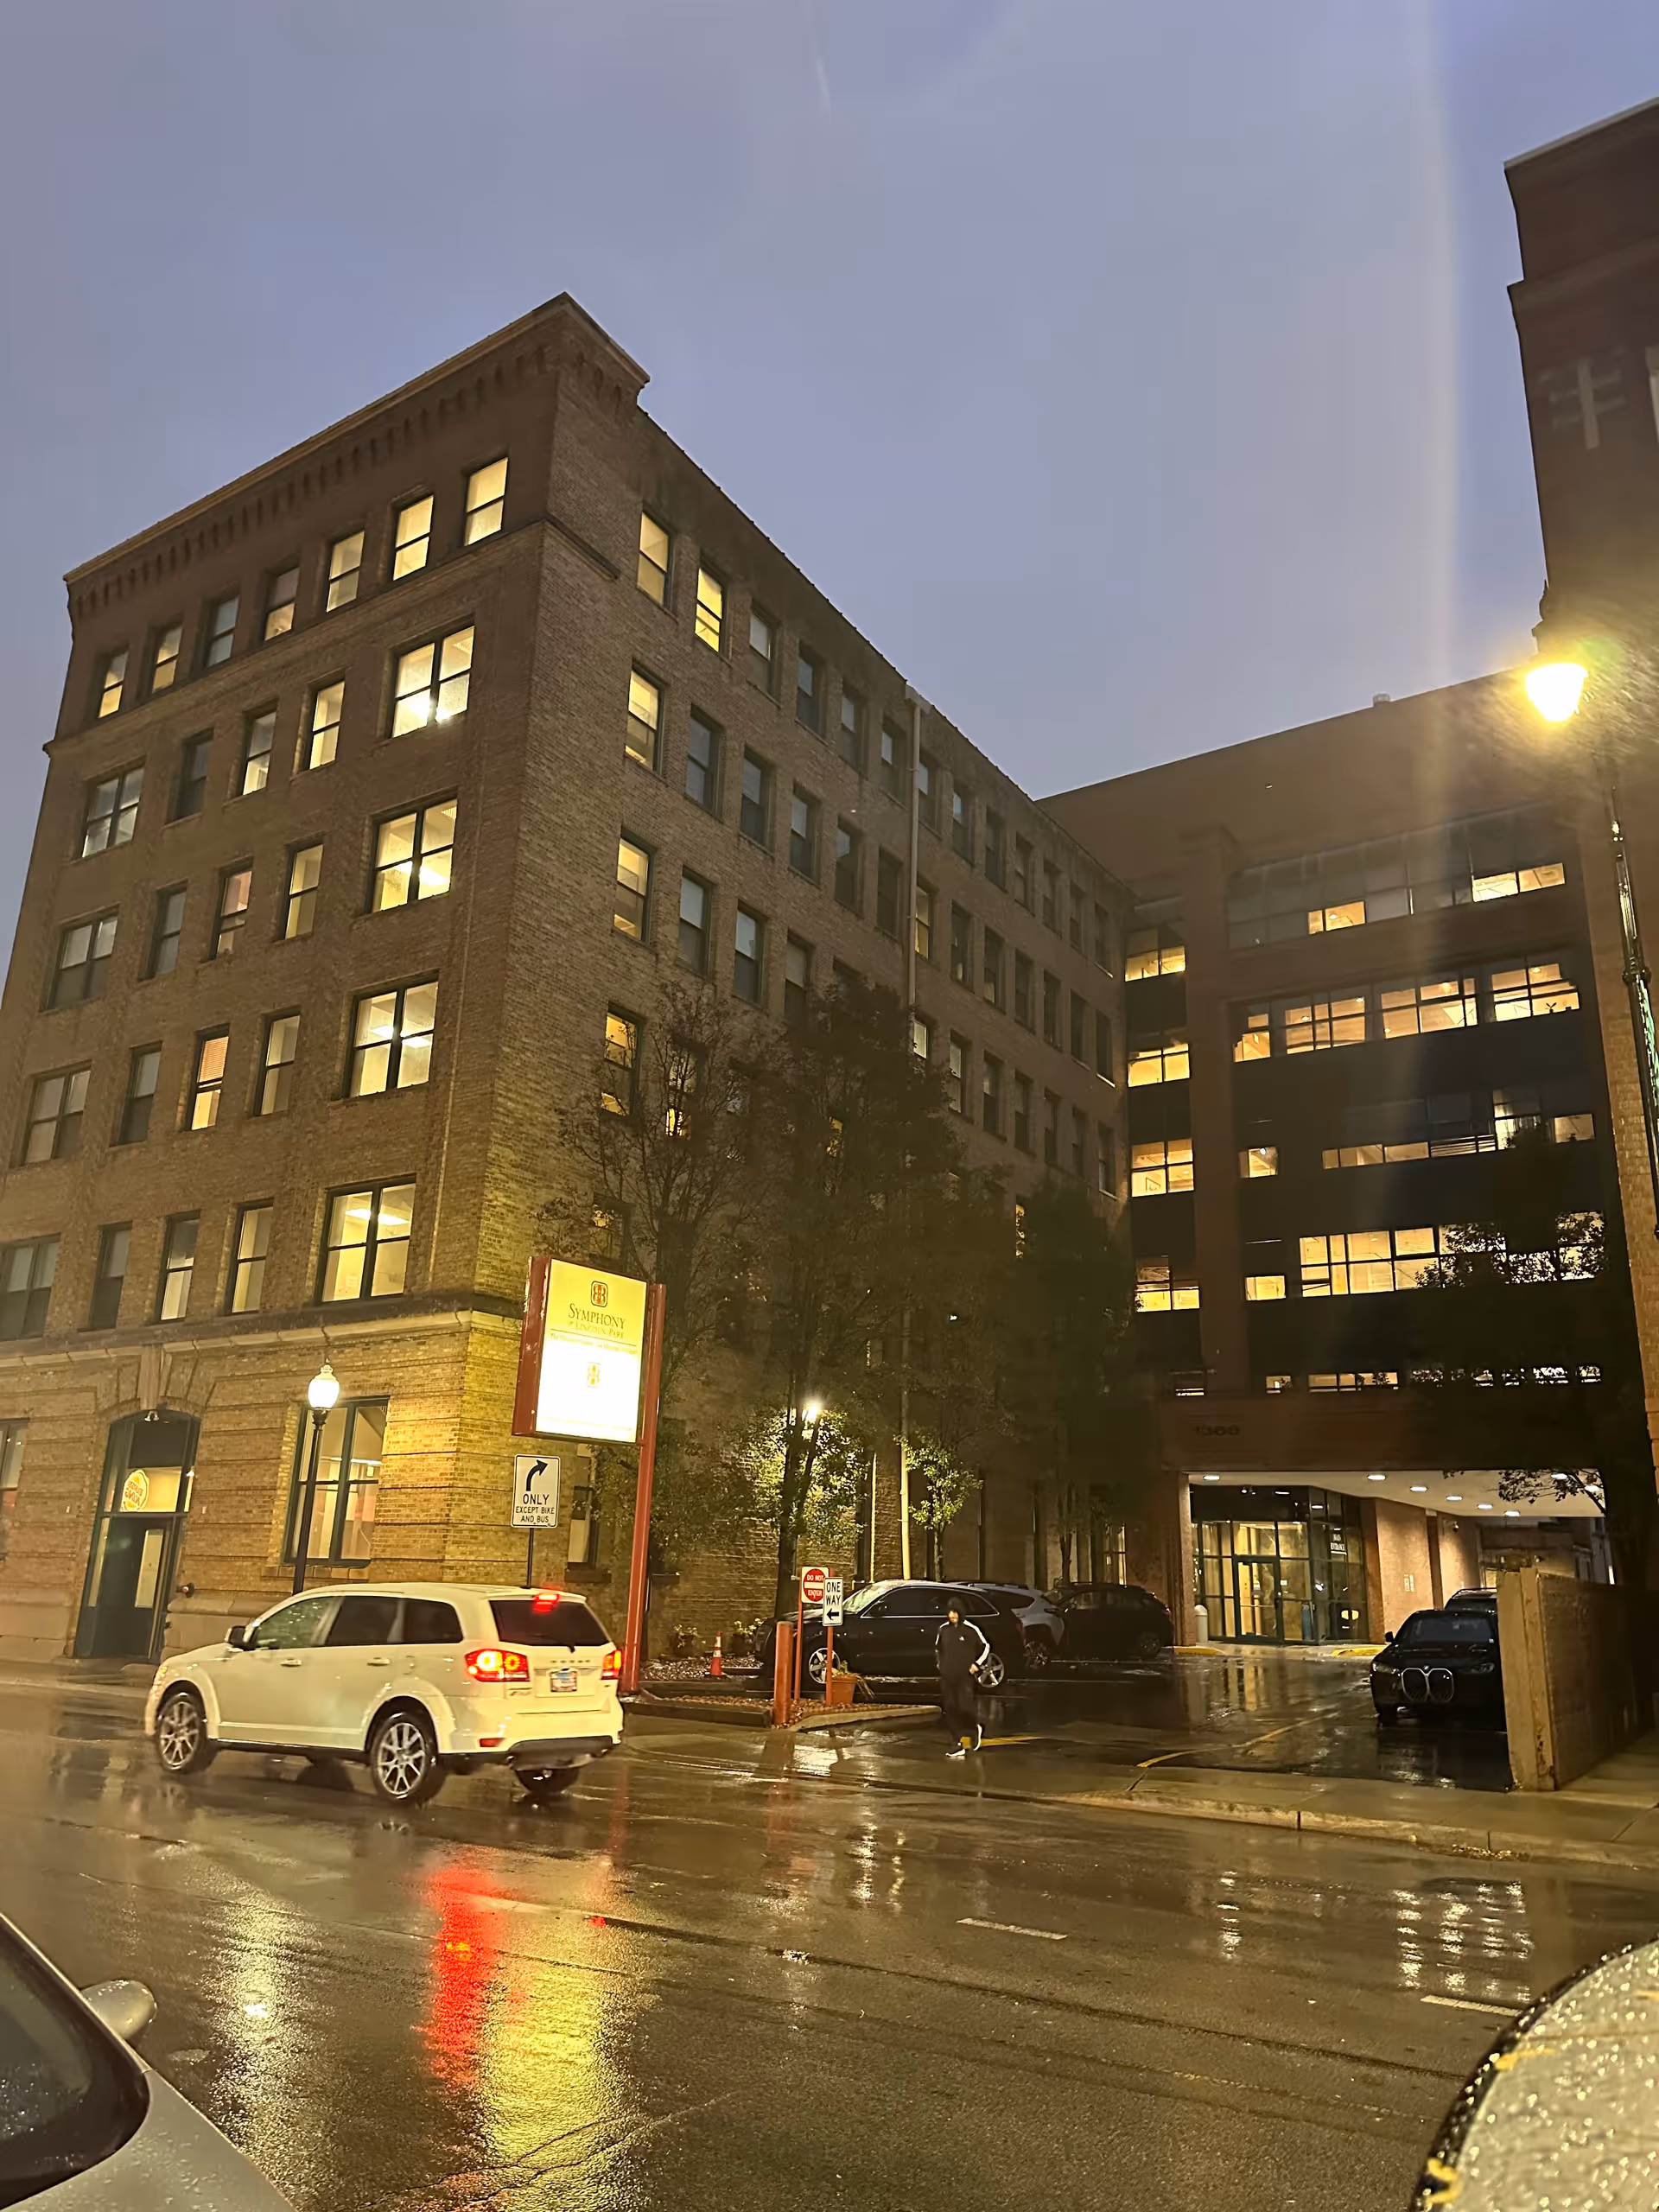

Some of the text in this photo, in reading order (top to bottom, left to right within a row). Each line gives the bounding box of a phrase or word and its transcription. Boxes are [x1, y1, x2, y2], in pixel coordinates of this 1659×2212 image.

[569, 1303, 626, 1329] SYMPHONY
[523, 1493, 550, 1505] ONLY
[826, 1581, 841, 1592] ONE
[826, 1594, 841, 1605] WAY
